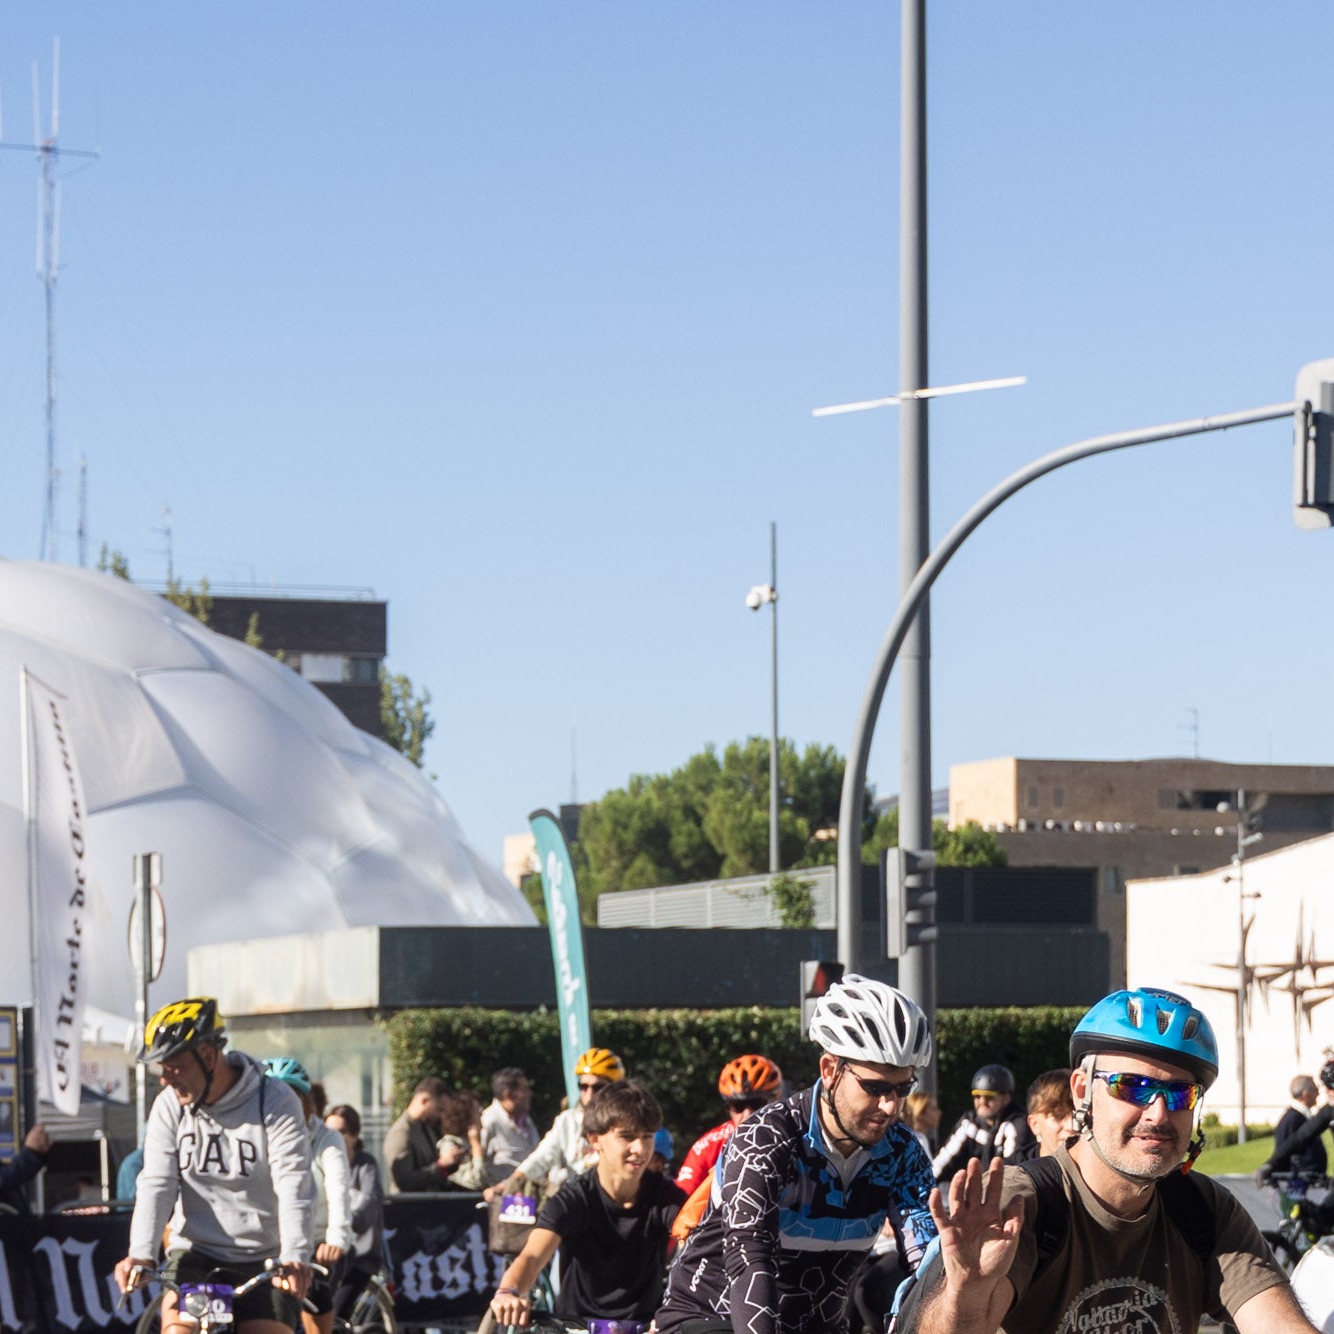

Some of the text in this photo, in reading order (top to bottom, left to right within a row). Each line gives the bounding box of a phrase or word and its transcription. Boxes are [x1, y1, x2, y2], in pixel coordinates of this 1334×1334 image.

[69, 868, 86, 909] de
[56, 917, 85, 1026] Norte
[178, 1132, 257, 1177] GAP
